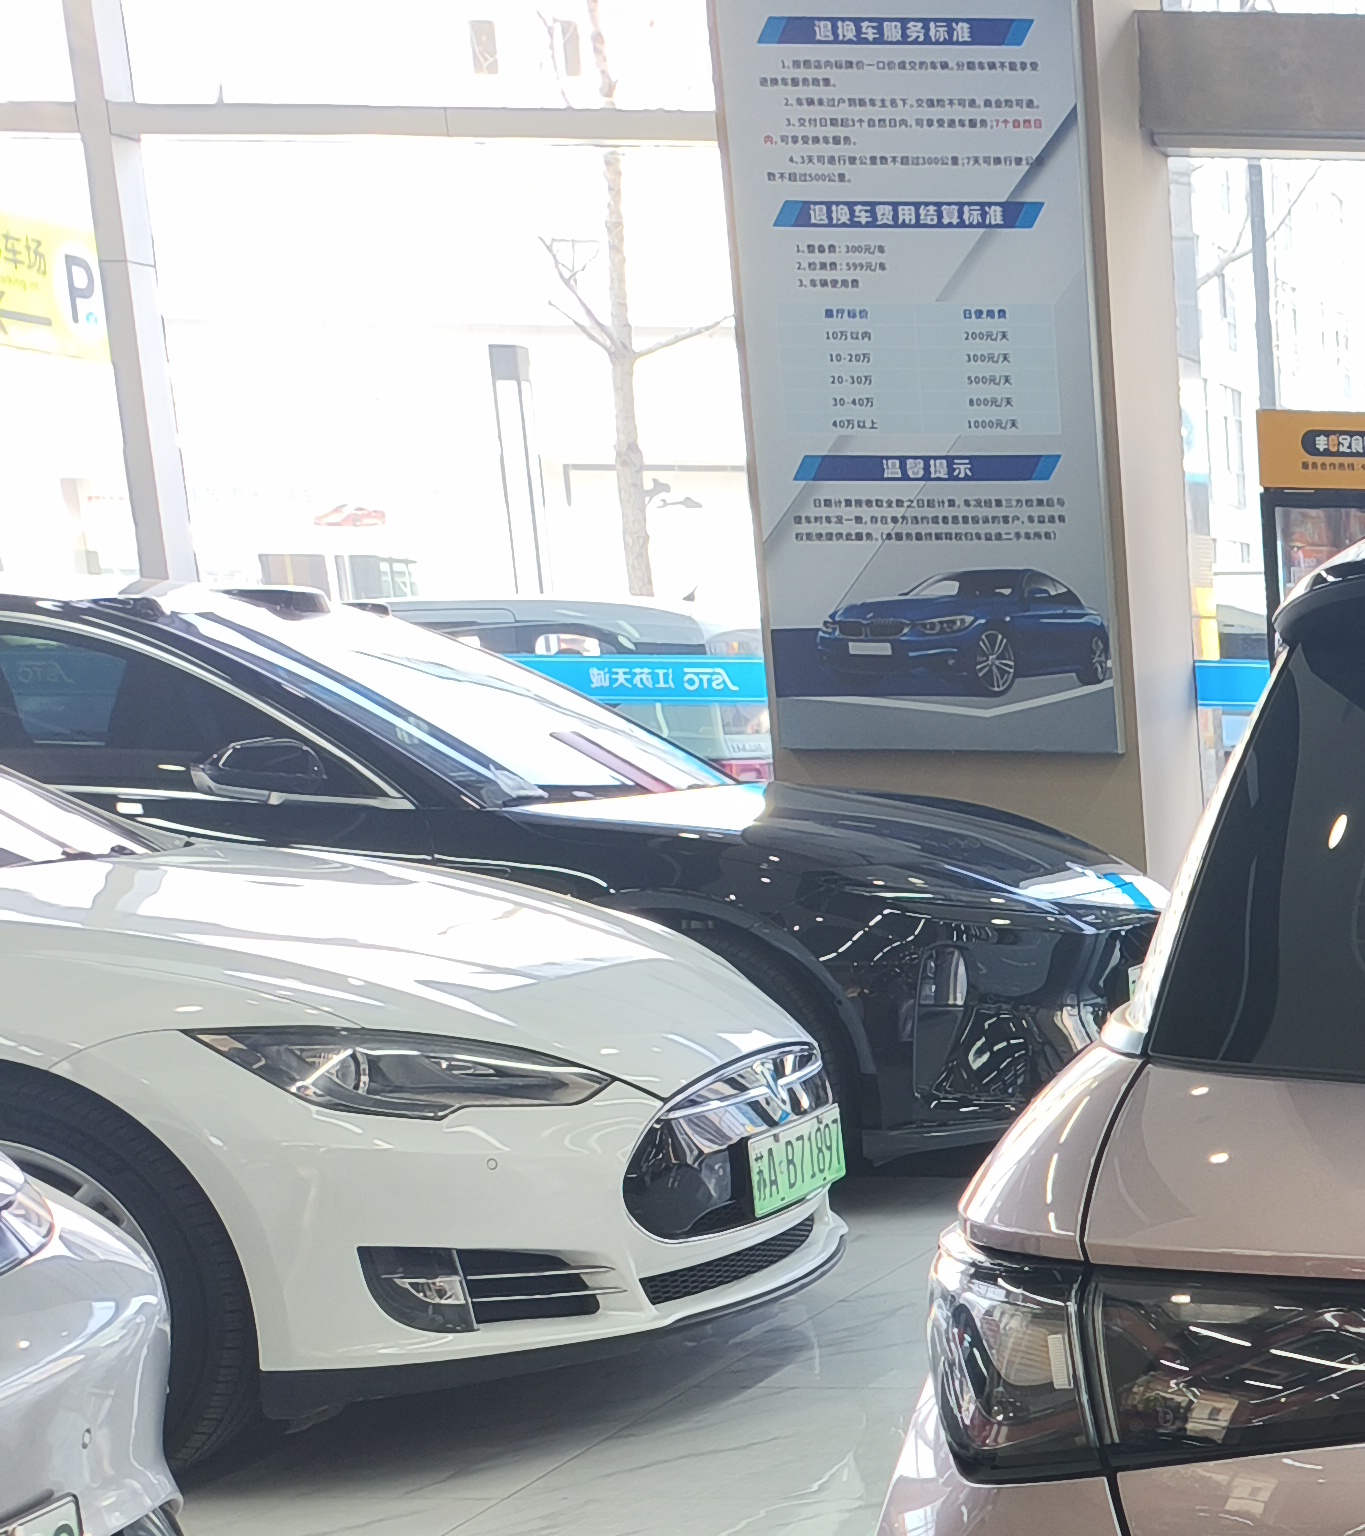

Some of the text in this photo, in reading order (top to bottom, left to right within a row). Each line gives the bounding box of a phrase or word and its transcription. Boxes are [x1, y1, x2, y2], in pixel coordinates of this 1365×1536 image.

[813, 20, 973, 43] 退换车服务标准
[808, 204, 1005, 226] 退换车费用结算标准
[0, 229, 47, 277] 车场
[64, 253, 95, 324] P
[824, 330, 872, 342] 10万以内
[963, 330, 1010, 342] 200元/天
[828, 352, 872, 364] 10-20万
[965, 352, 1011, 364] 300元/天
[829, 375, 873, 386] 20-30万
[966, 374, 1013, 386] 500元/天
[831, 396, 874, 408] 30-40万
[831, 418, 879, 430] 40万以上
[966, 418, 1019, 430] 1000元/天
[882, 458, 973, 479] 温馨提示
